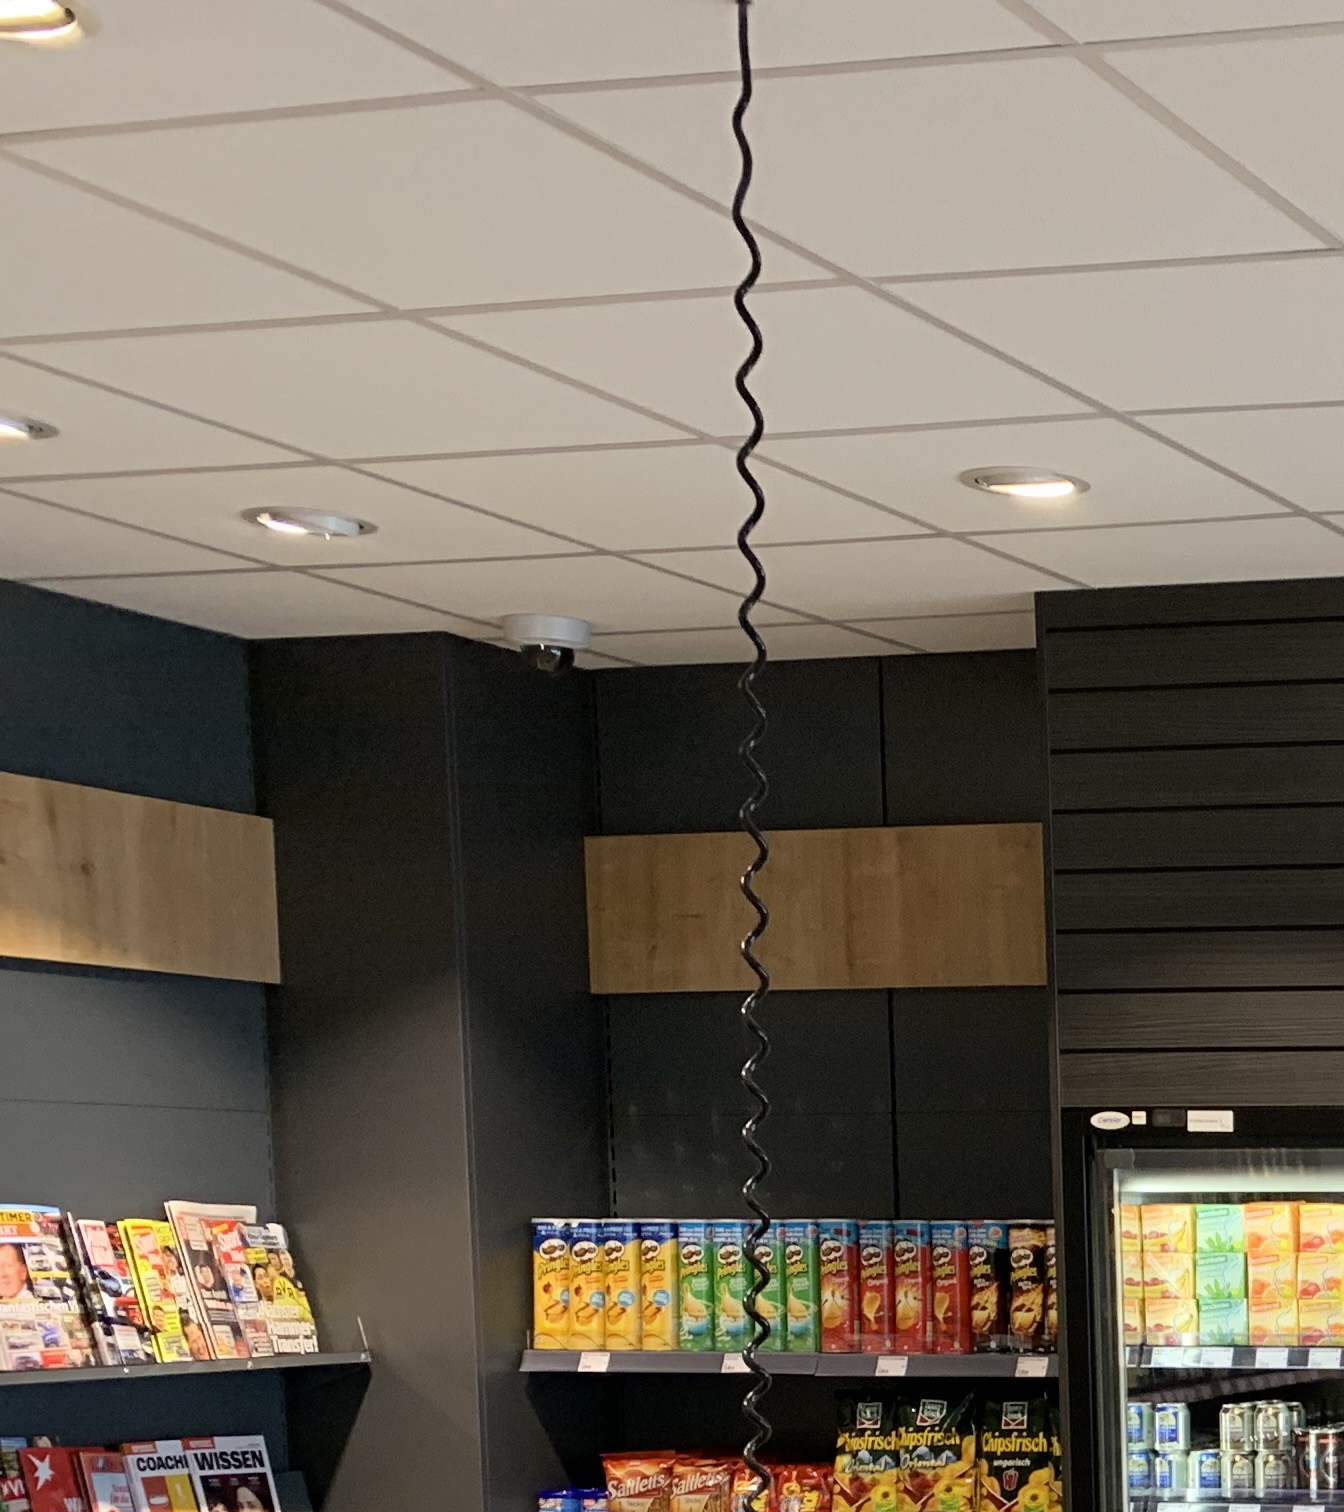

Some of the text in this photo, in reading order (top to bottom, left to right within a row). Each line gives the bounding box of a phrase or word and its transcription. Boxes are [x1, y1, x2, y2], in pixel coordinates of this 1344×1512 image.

[982, 1431, 1048, 1454] Chipsfrisch
[136, 1454, 189, 1472] COACHI
[194, 1450, 266, 1472] WISSEN
[900, 1453, 947, 1471] Oriental
[992, 1457, 1032, 1468] ungarisch
[606, 1472, 667, 1500] Saltletts
[670, 1469, 728, 1498] Saltletts
